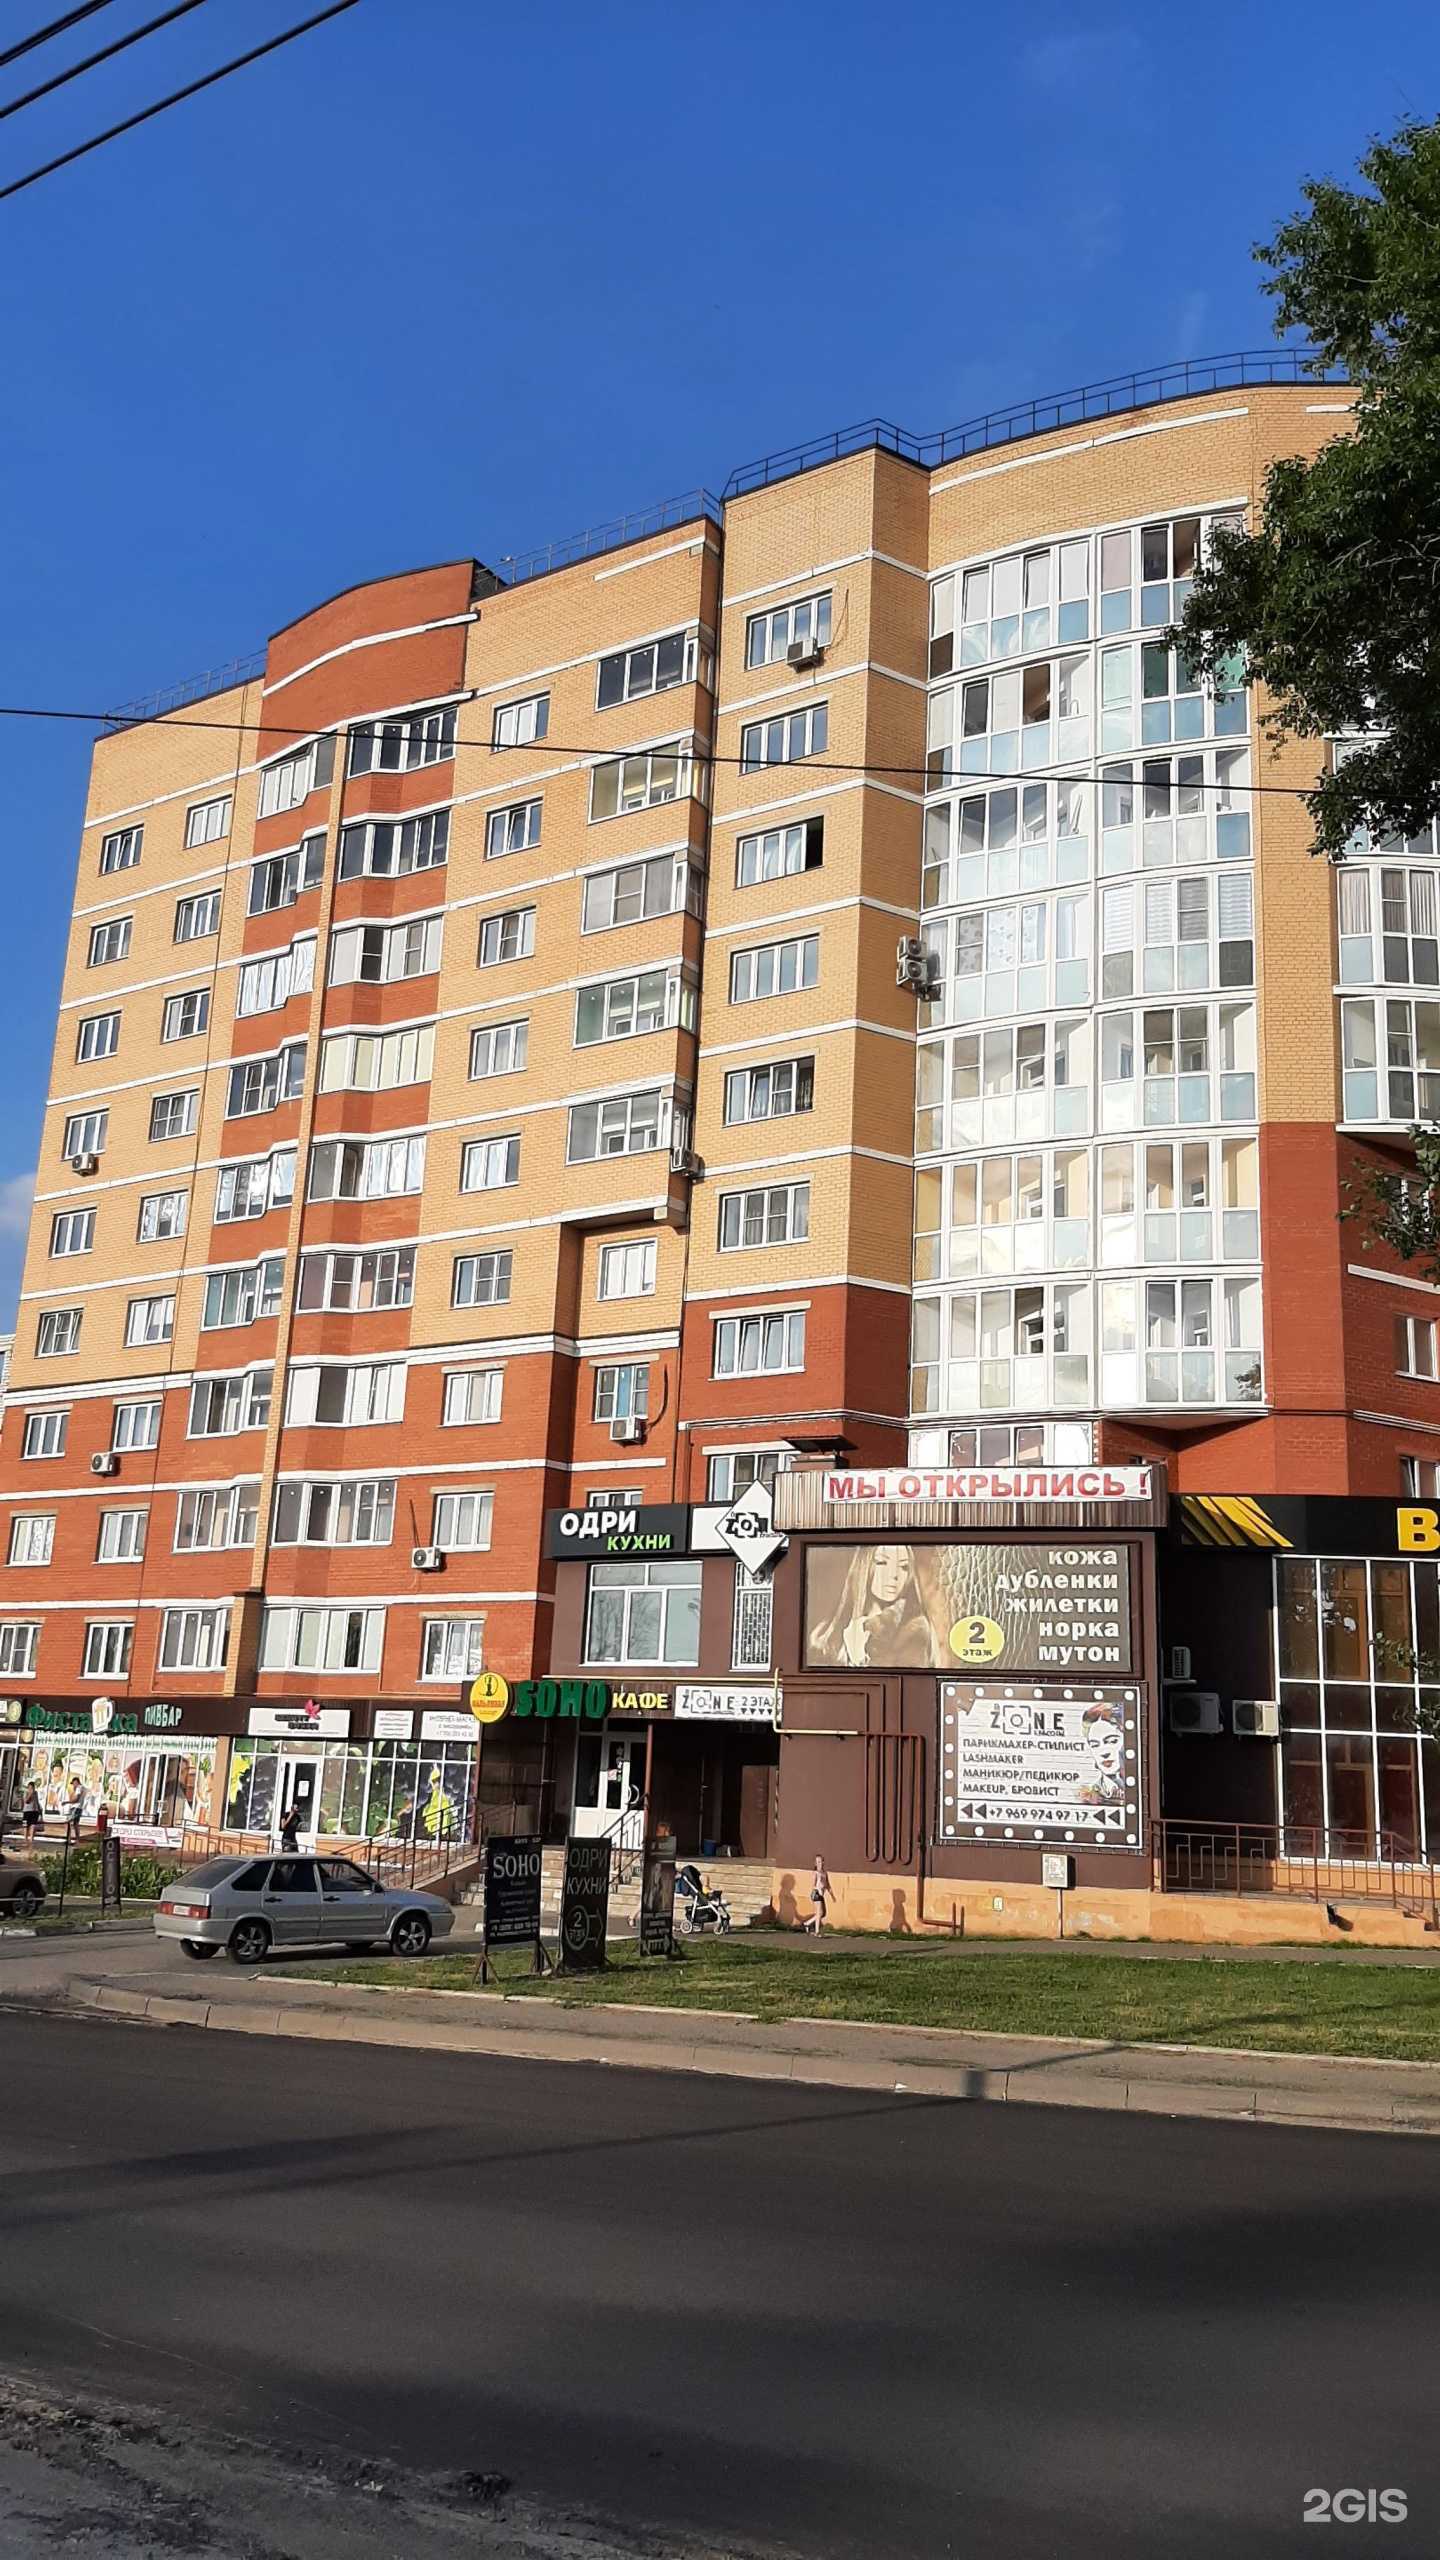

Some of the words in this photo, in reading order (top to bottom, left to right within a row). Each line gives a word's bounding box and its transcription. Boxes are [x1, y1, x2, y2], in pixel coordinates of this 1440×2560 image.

[828, 1477, 885, 1499] МЫ
[899, 1472, 1125, 1498] ОТКРЫЛИСЬ
[559, 1510, 637, 1539] ОДРИ
[606, 1534, 671, 1551] КУХНИ
[1048, 1550, 1118, 1566] кожа
[994, 1569, 1118, 1592] дубленки
[1005, 1598, 1119, 1613] жилетки
[968, 1621, 985, 1644] 2
[1039, 1622, 1120, 1641] норка
[962, 1648, 993, 1657] этаж
[1038, 1646, 1120, 1665] мутон
[515, 1680, 609, 1719] SOHO
[612, 1692, 670, 1710] КАФЕ
[741, 1696, 748, 1706] 2
[962, 1738, 1086, 1751] ПАРИКМАХЕР-СТИЛИСТ
[962, 1753, 1024, 1764] LASHMAKER
[962, 1768, 1080, 1782] МАНИКЮР/ПЕДИКЮР
[493, 1853, 540, 1879] SOHO
[569, 1847, 608, 1873] ОДРИ
[566, 1876, 607, 1895] КУХНИ
[573, 1911, 582, 1928] 2
